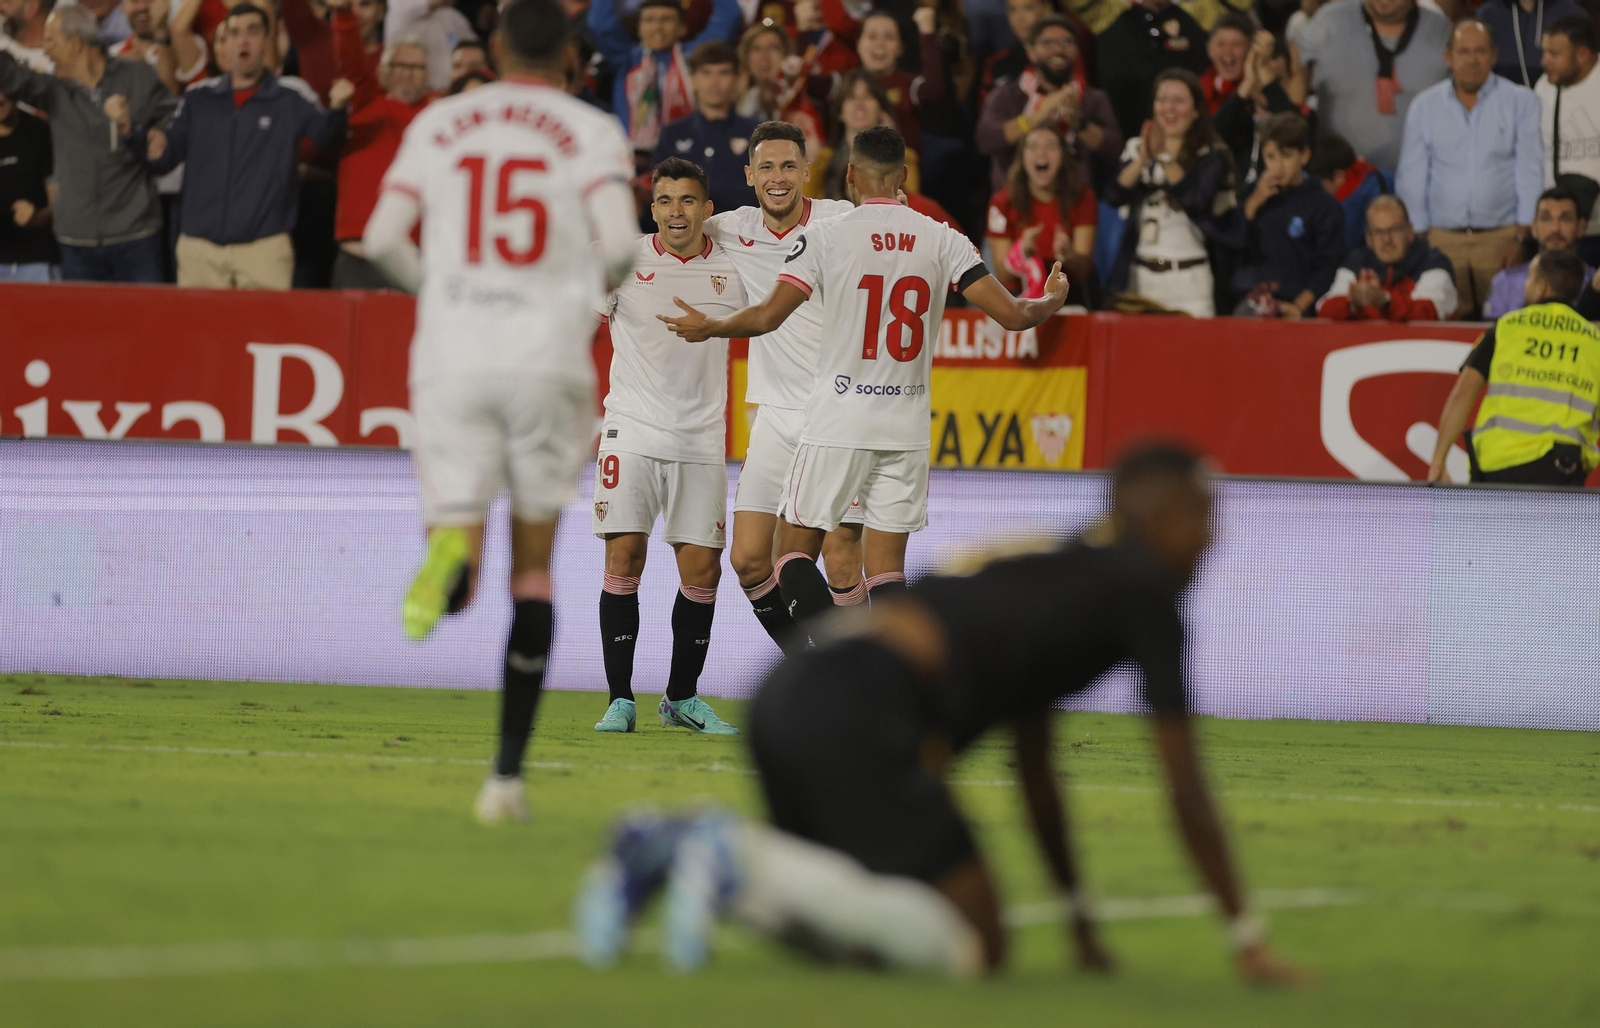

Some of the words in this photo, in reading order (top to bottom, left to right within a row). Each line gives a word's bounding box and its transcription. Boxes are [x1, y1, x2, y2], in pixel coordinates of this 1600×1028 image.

[456, 155, 549, 267] 15
[871, 232, 916, 252] SOW
[857, 274, 931, 362] 18
[1524, 337, 1579, 363] 2011
[1517, 366, 1594, 394] PROSEGUR
[598, 454, 620, 489] 19
